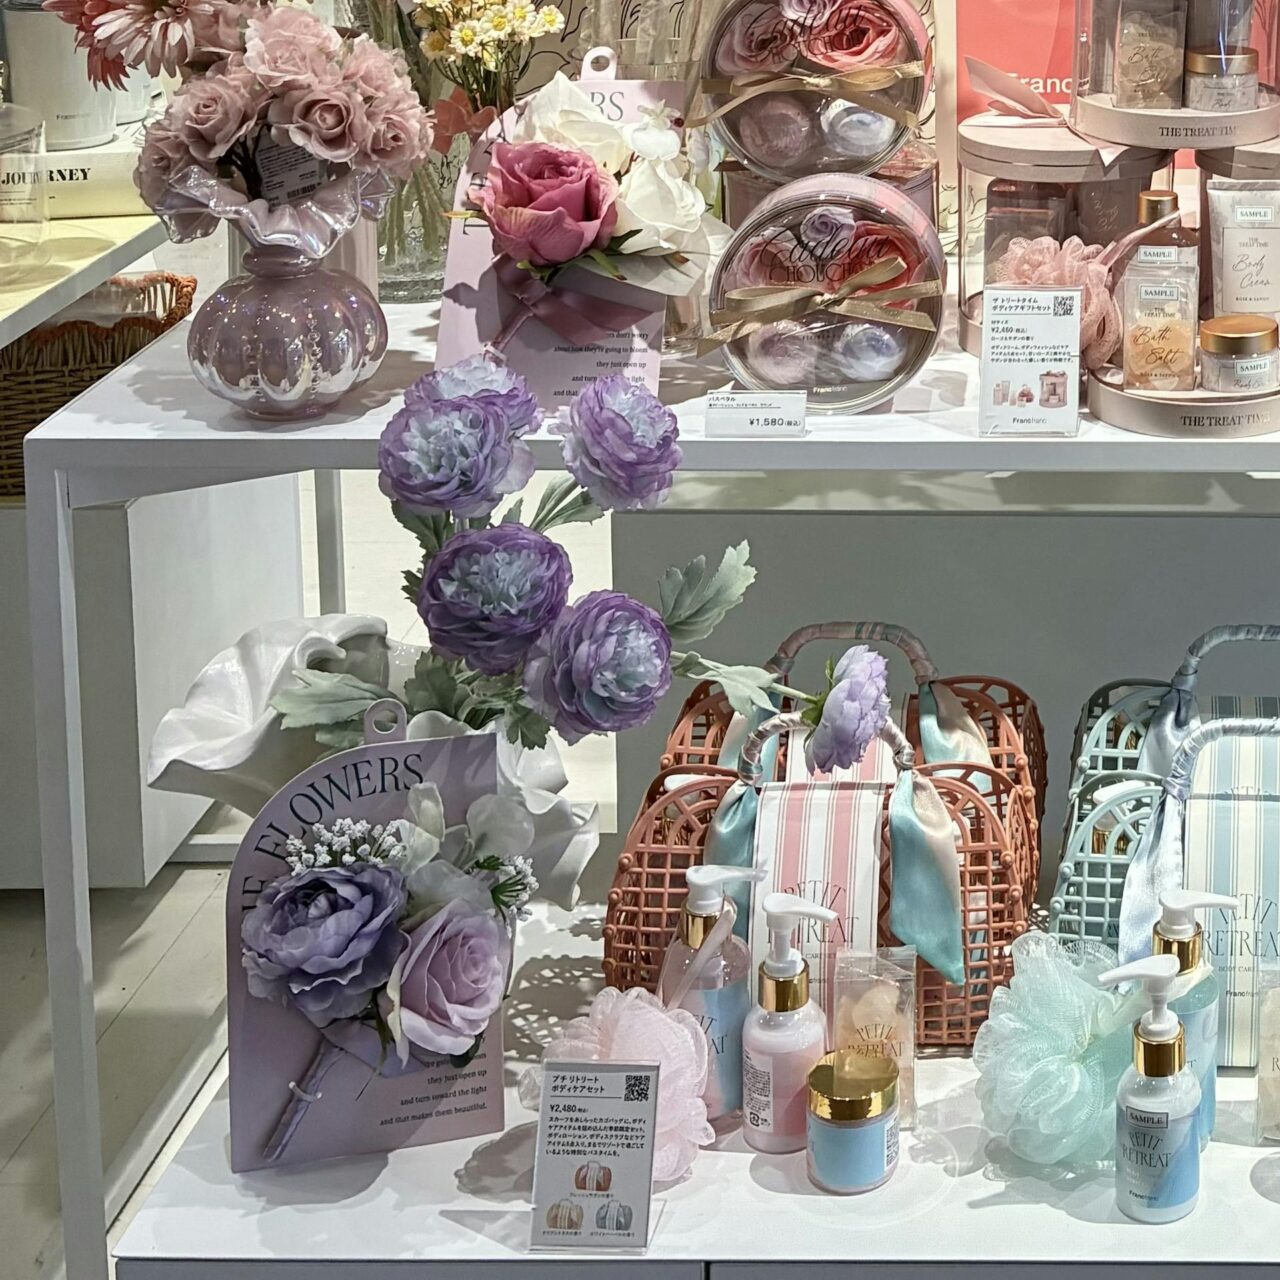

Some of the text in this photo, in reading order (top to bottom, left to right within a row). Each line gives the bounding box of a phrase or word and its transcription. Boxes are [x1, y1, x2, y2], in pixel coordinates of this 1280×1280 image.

[1158, 125, 1239, 137] THE TREAT TIM
[1239, 210, 1269, 219] SAMPLE
[1143, 251, 1172, 259] SAMPLE
[1144, 289, 1174, 298] SAMPLE
[1239, 363, 1268, 372] SAMPLE
[1181, 413, 1267, 427] THE TREAT TIM
[551, 1085, 605, 1093] ボディケアセット
[1130, 1112, 1164, 1125] SAMPLE
